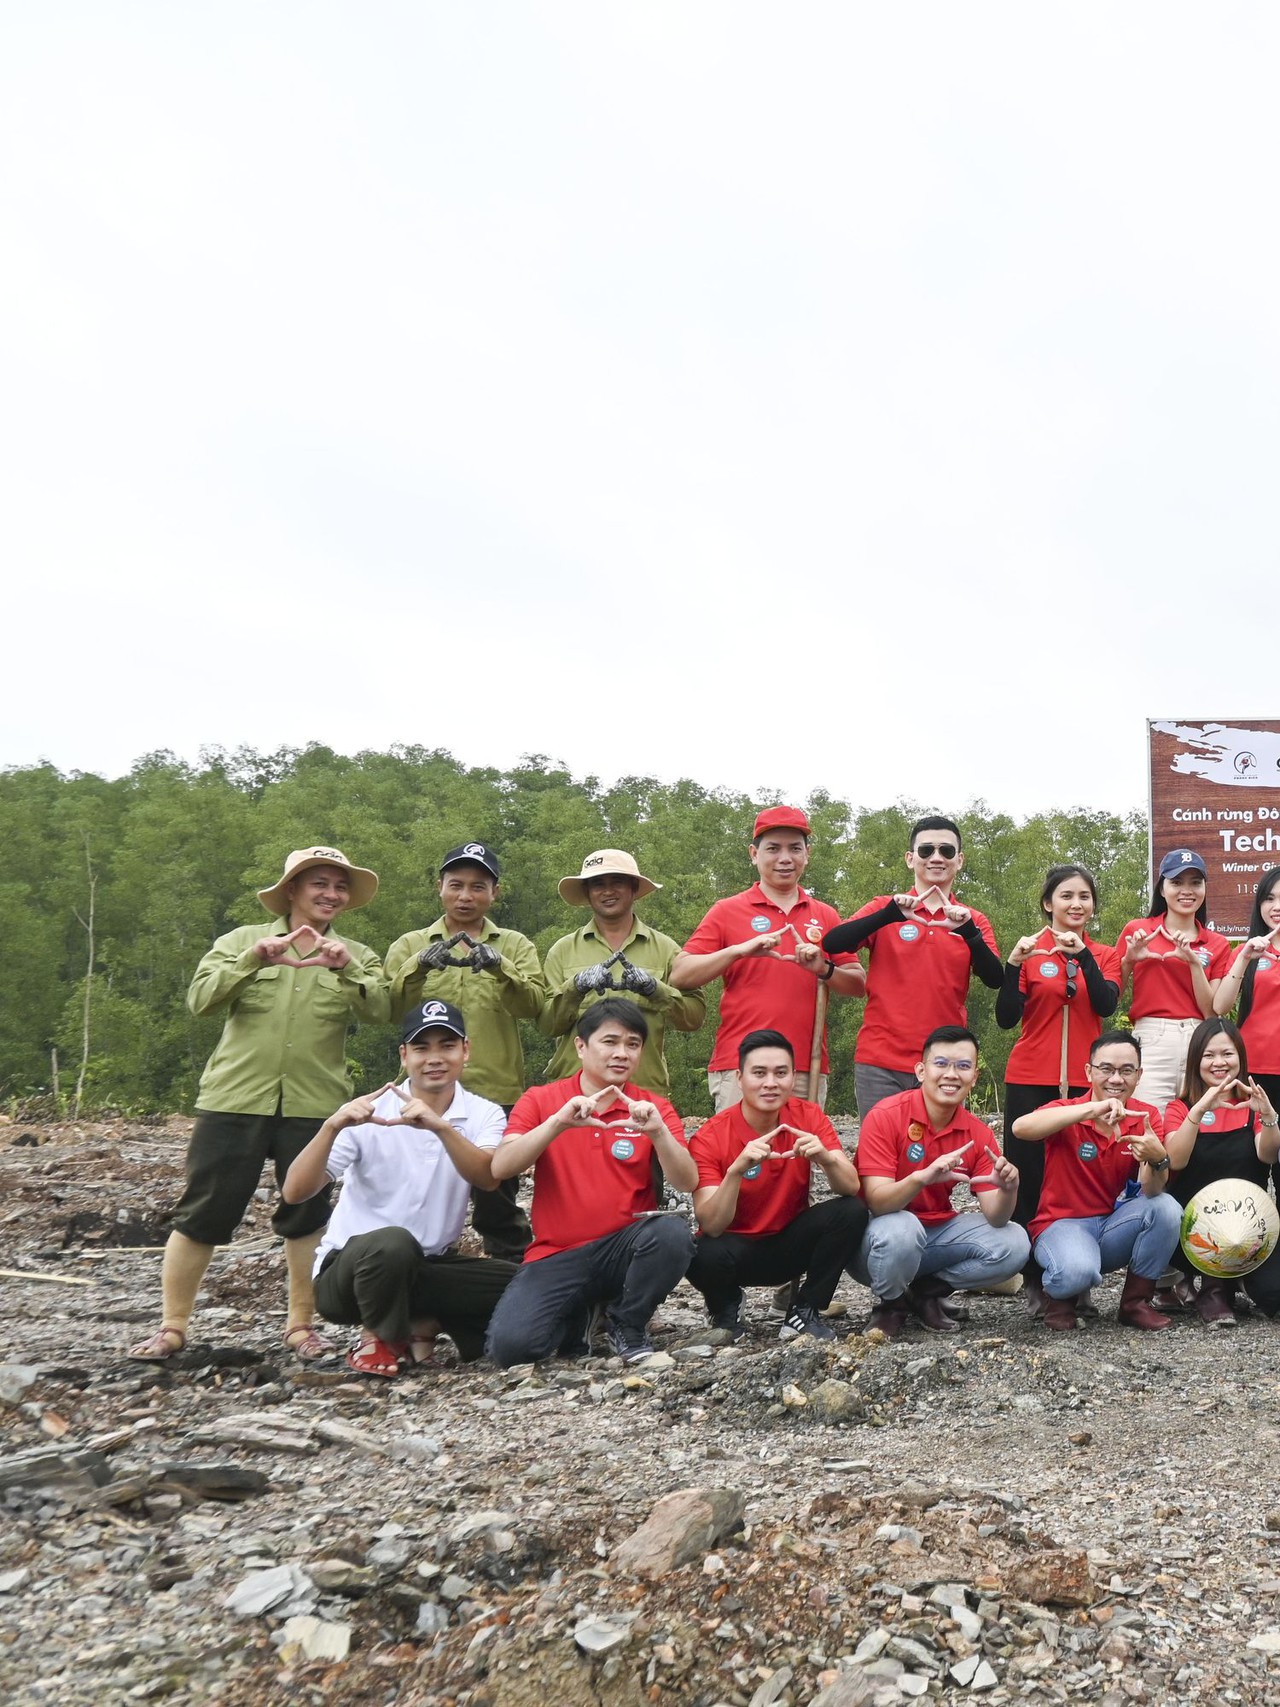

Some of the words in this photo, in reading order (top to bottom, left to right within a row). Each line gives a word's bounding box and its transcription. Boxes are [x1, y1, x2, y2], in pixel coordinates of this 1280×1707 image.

[1172, 808, 1212, 821] Cánh
[1217, 808, 1253, 823] rừng
[1222, 863, 1260, 872] Winter
